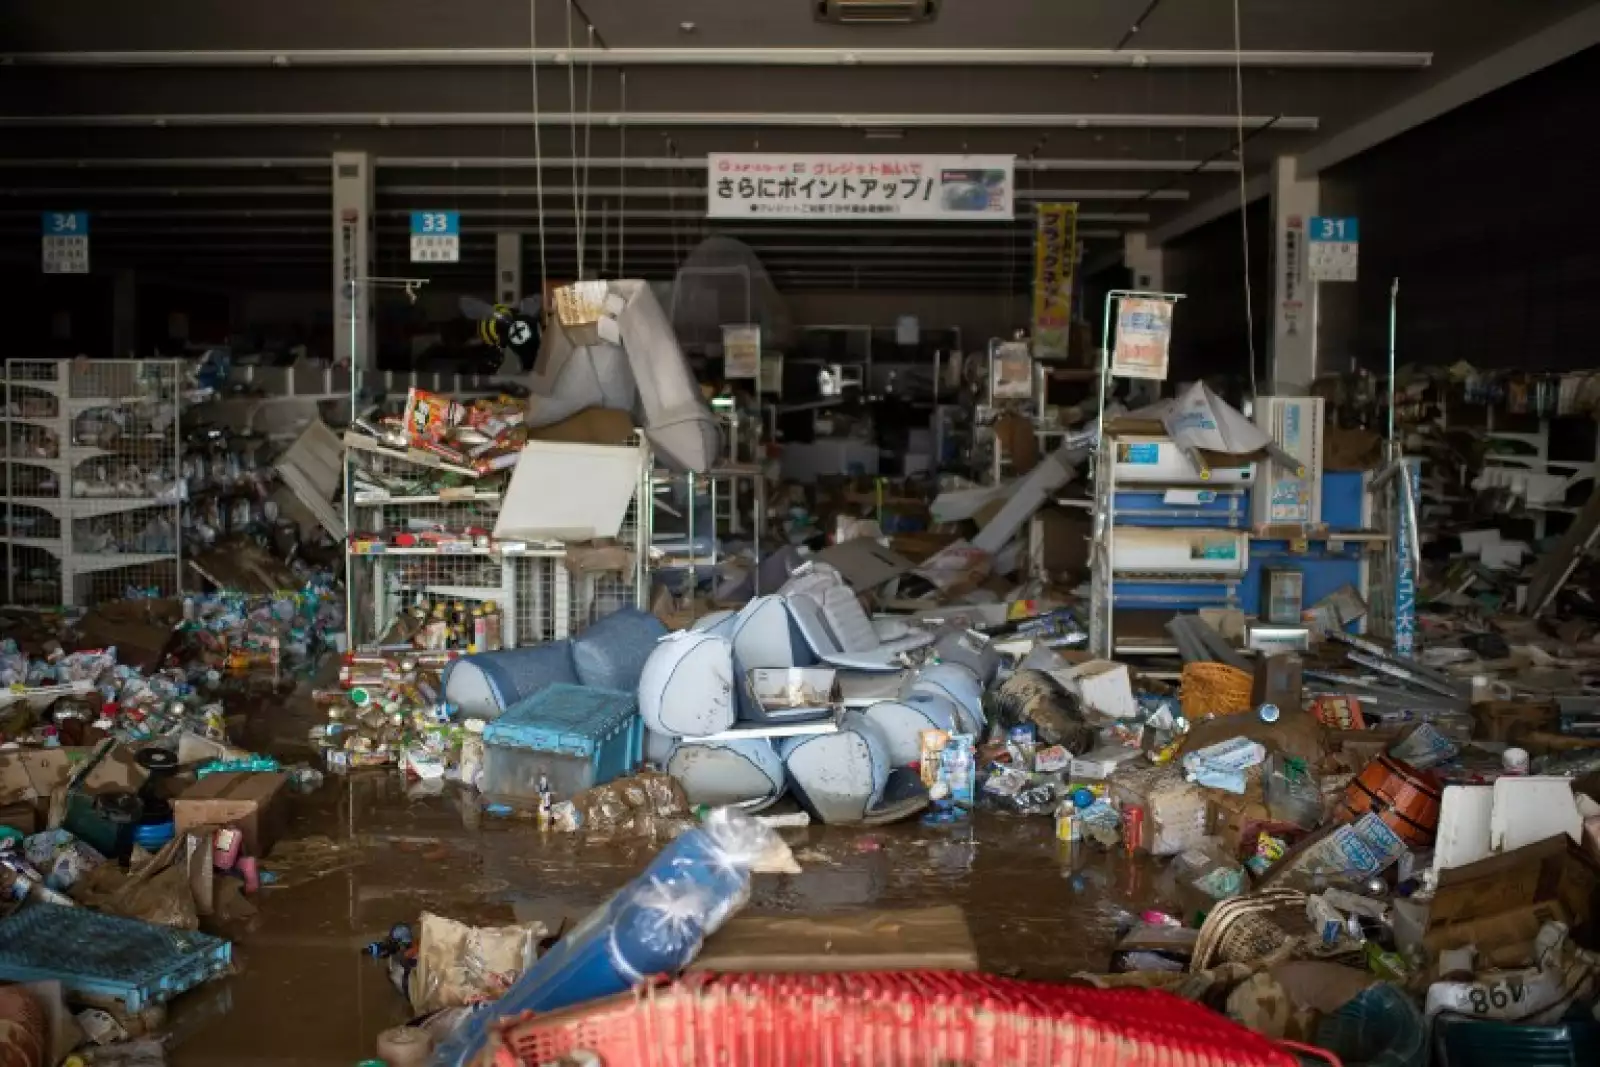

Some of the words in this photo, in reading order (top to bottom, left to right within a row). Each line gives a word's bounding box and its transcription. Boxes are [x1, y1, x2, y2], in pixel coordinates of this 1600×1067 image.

[52, 213, 77, 232] 34
[422, 213, 447, 232] 33
[1321, 218, 1345, 238] 31
